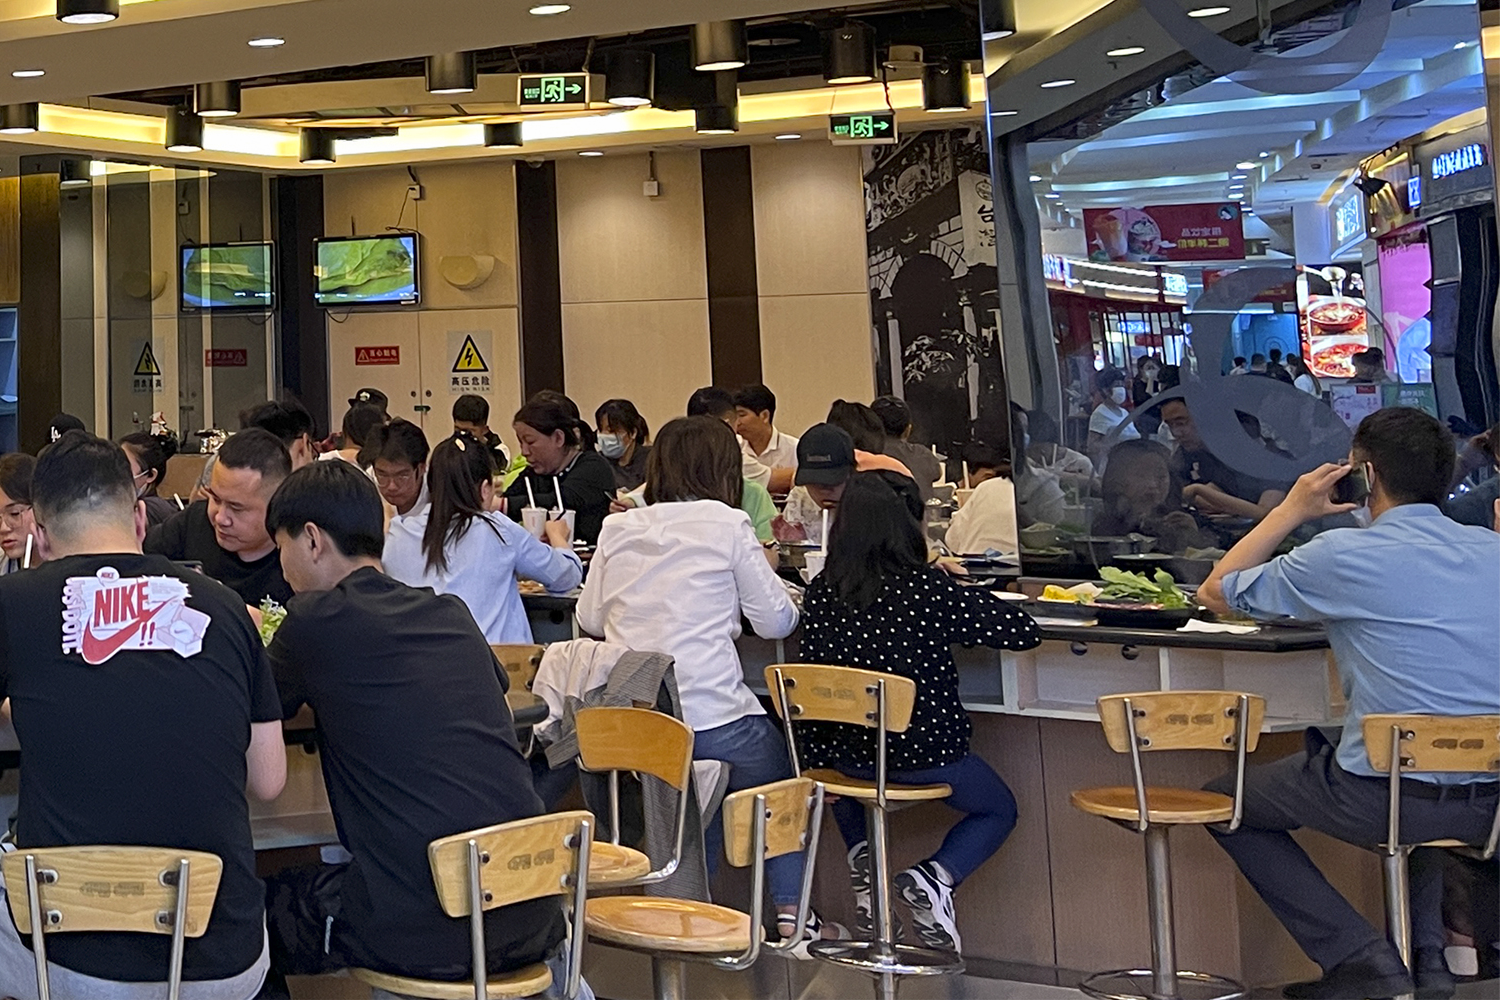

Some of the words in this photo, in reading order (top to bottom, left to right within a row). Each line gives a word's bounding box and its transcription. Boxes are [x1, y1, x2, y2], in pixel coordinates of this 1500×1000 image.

[451, 376, 490, 386] 高压危险
[93, 581, 150, 628] NIKE
